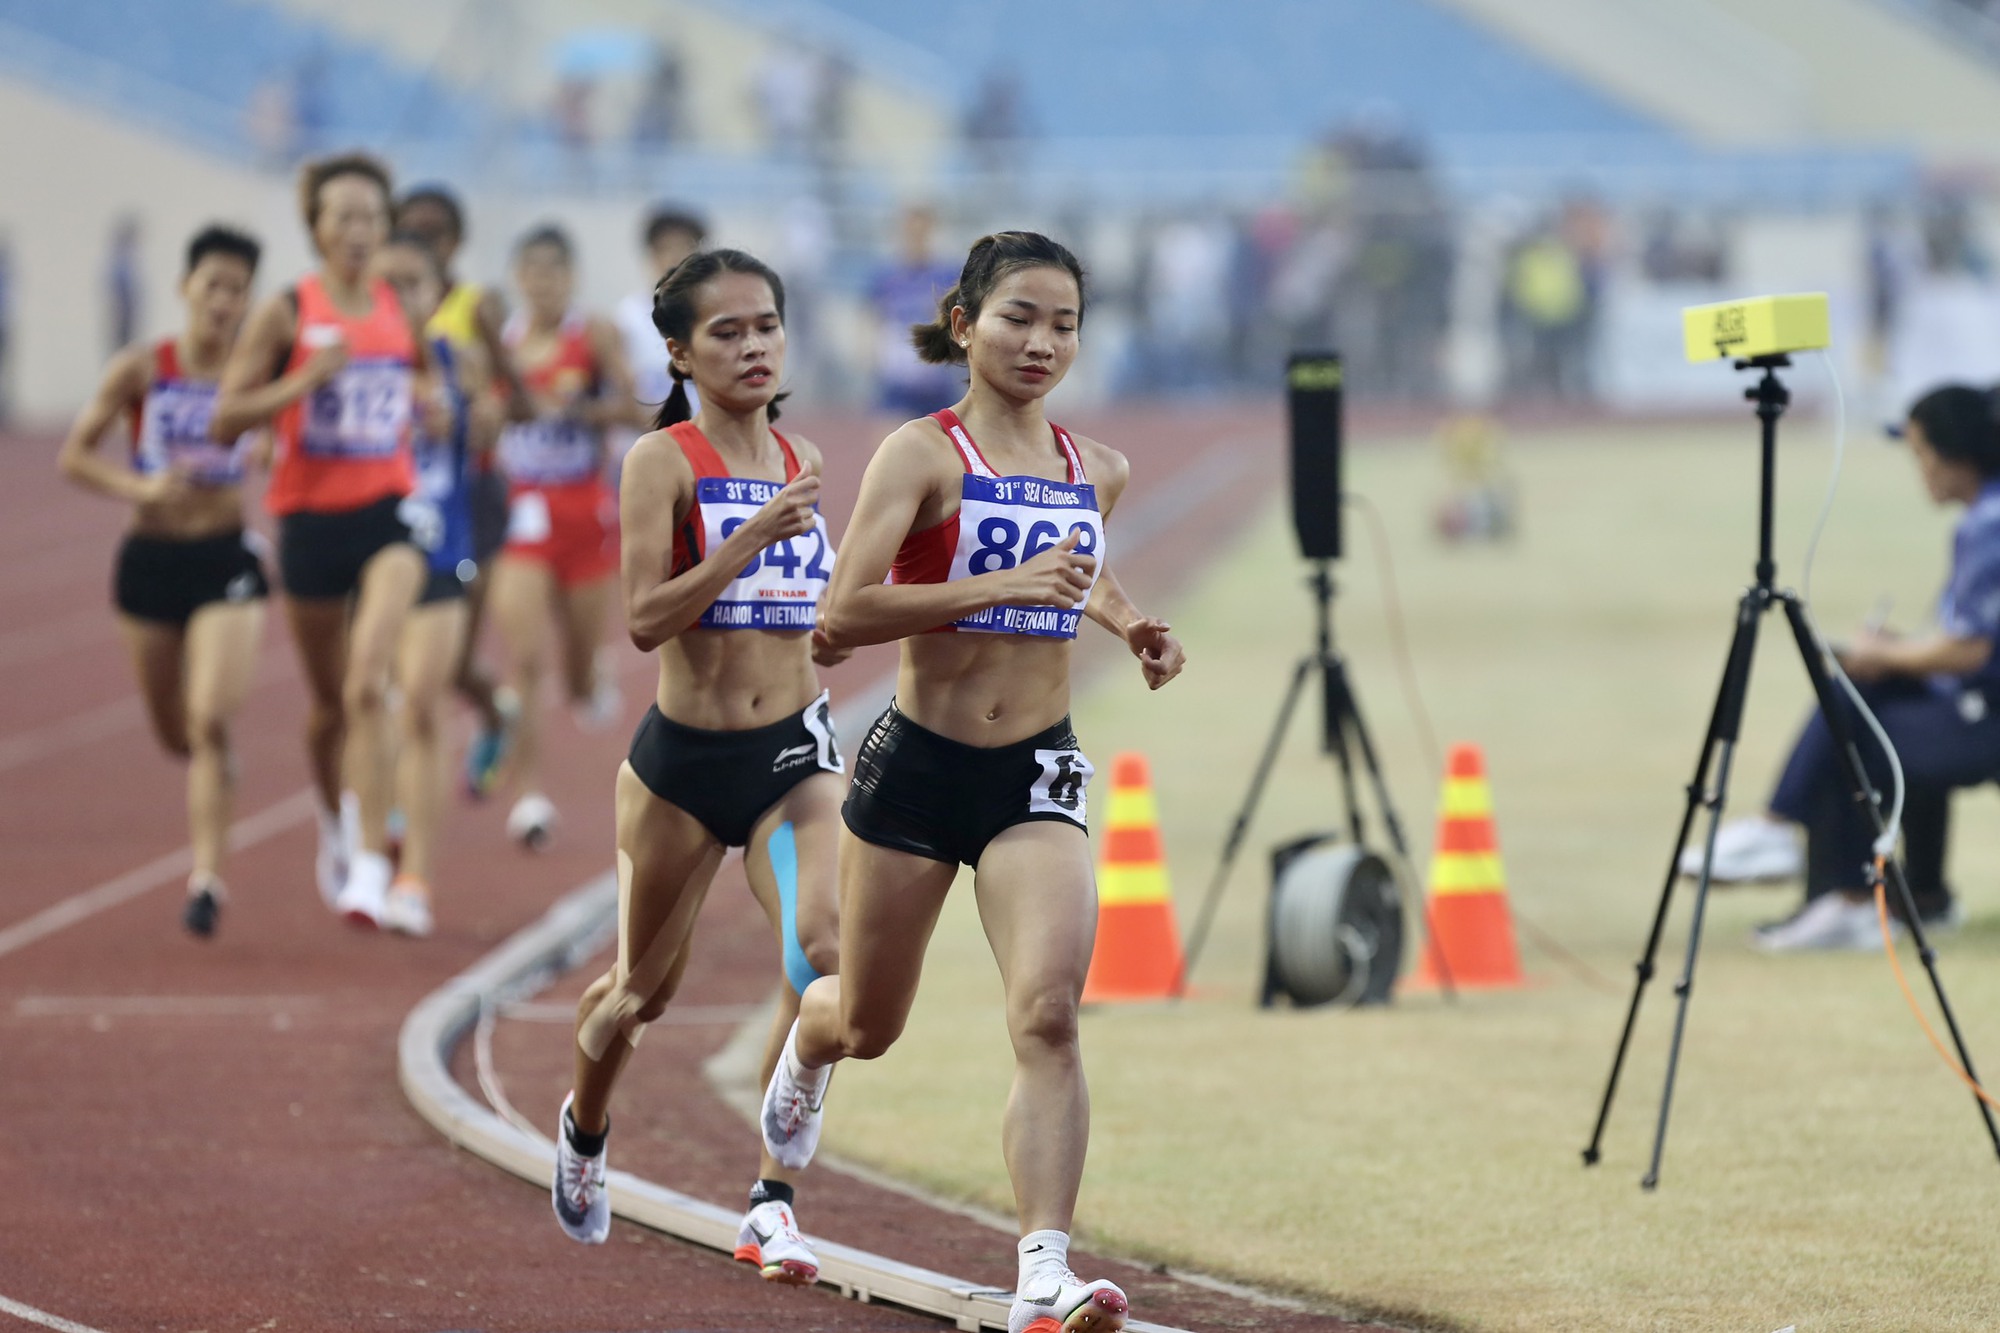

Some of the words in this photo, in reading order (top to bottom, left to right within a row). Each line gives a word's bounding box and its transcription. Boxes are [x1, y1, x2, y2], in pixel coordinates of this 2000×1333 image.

[749, 483, 771, 502] SEA
[995, 481, 1021, 500] 31ST
[1024, 481, 1040, 503] SEA
[1042, 485, 1080, 505] Games
[968, 516, 1097, 576] 868
[758, 589, 808, 598] VIETNAM
[713, 605, 752, 625] HANOI
[957, 606, 994, 624] NOI
[1003, 608, 1059, 631] VIETNAM
[1047, 754, 1086, 811] 6
